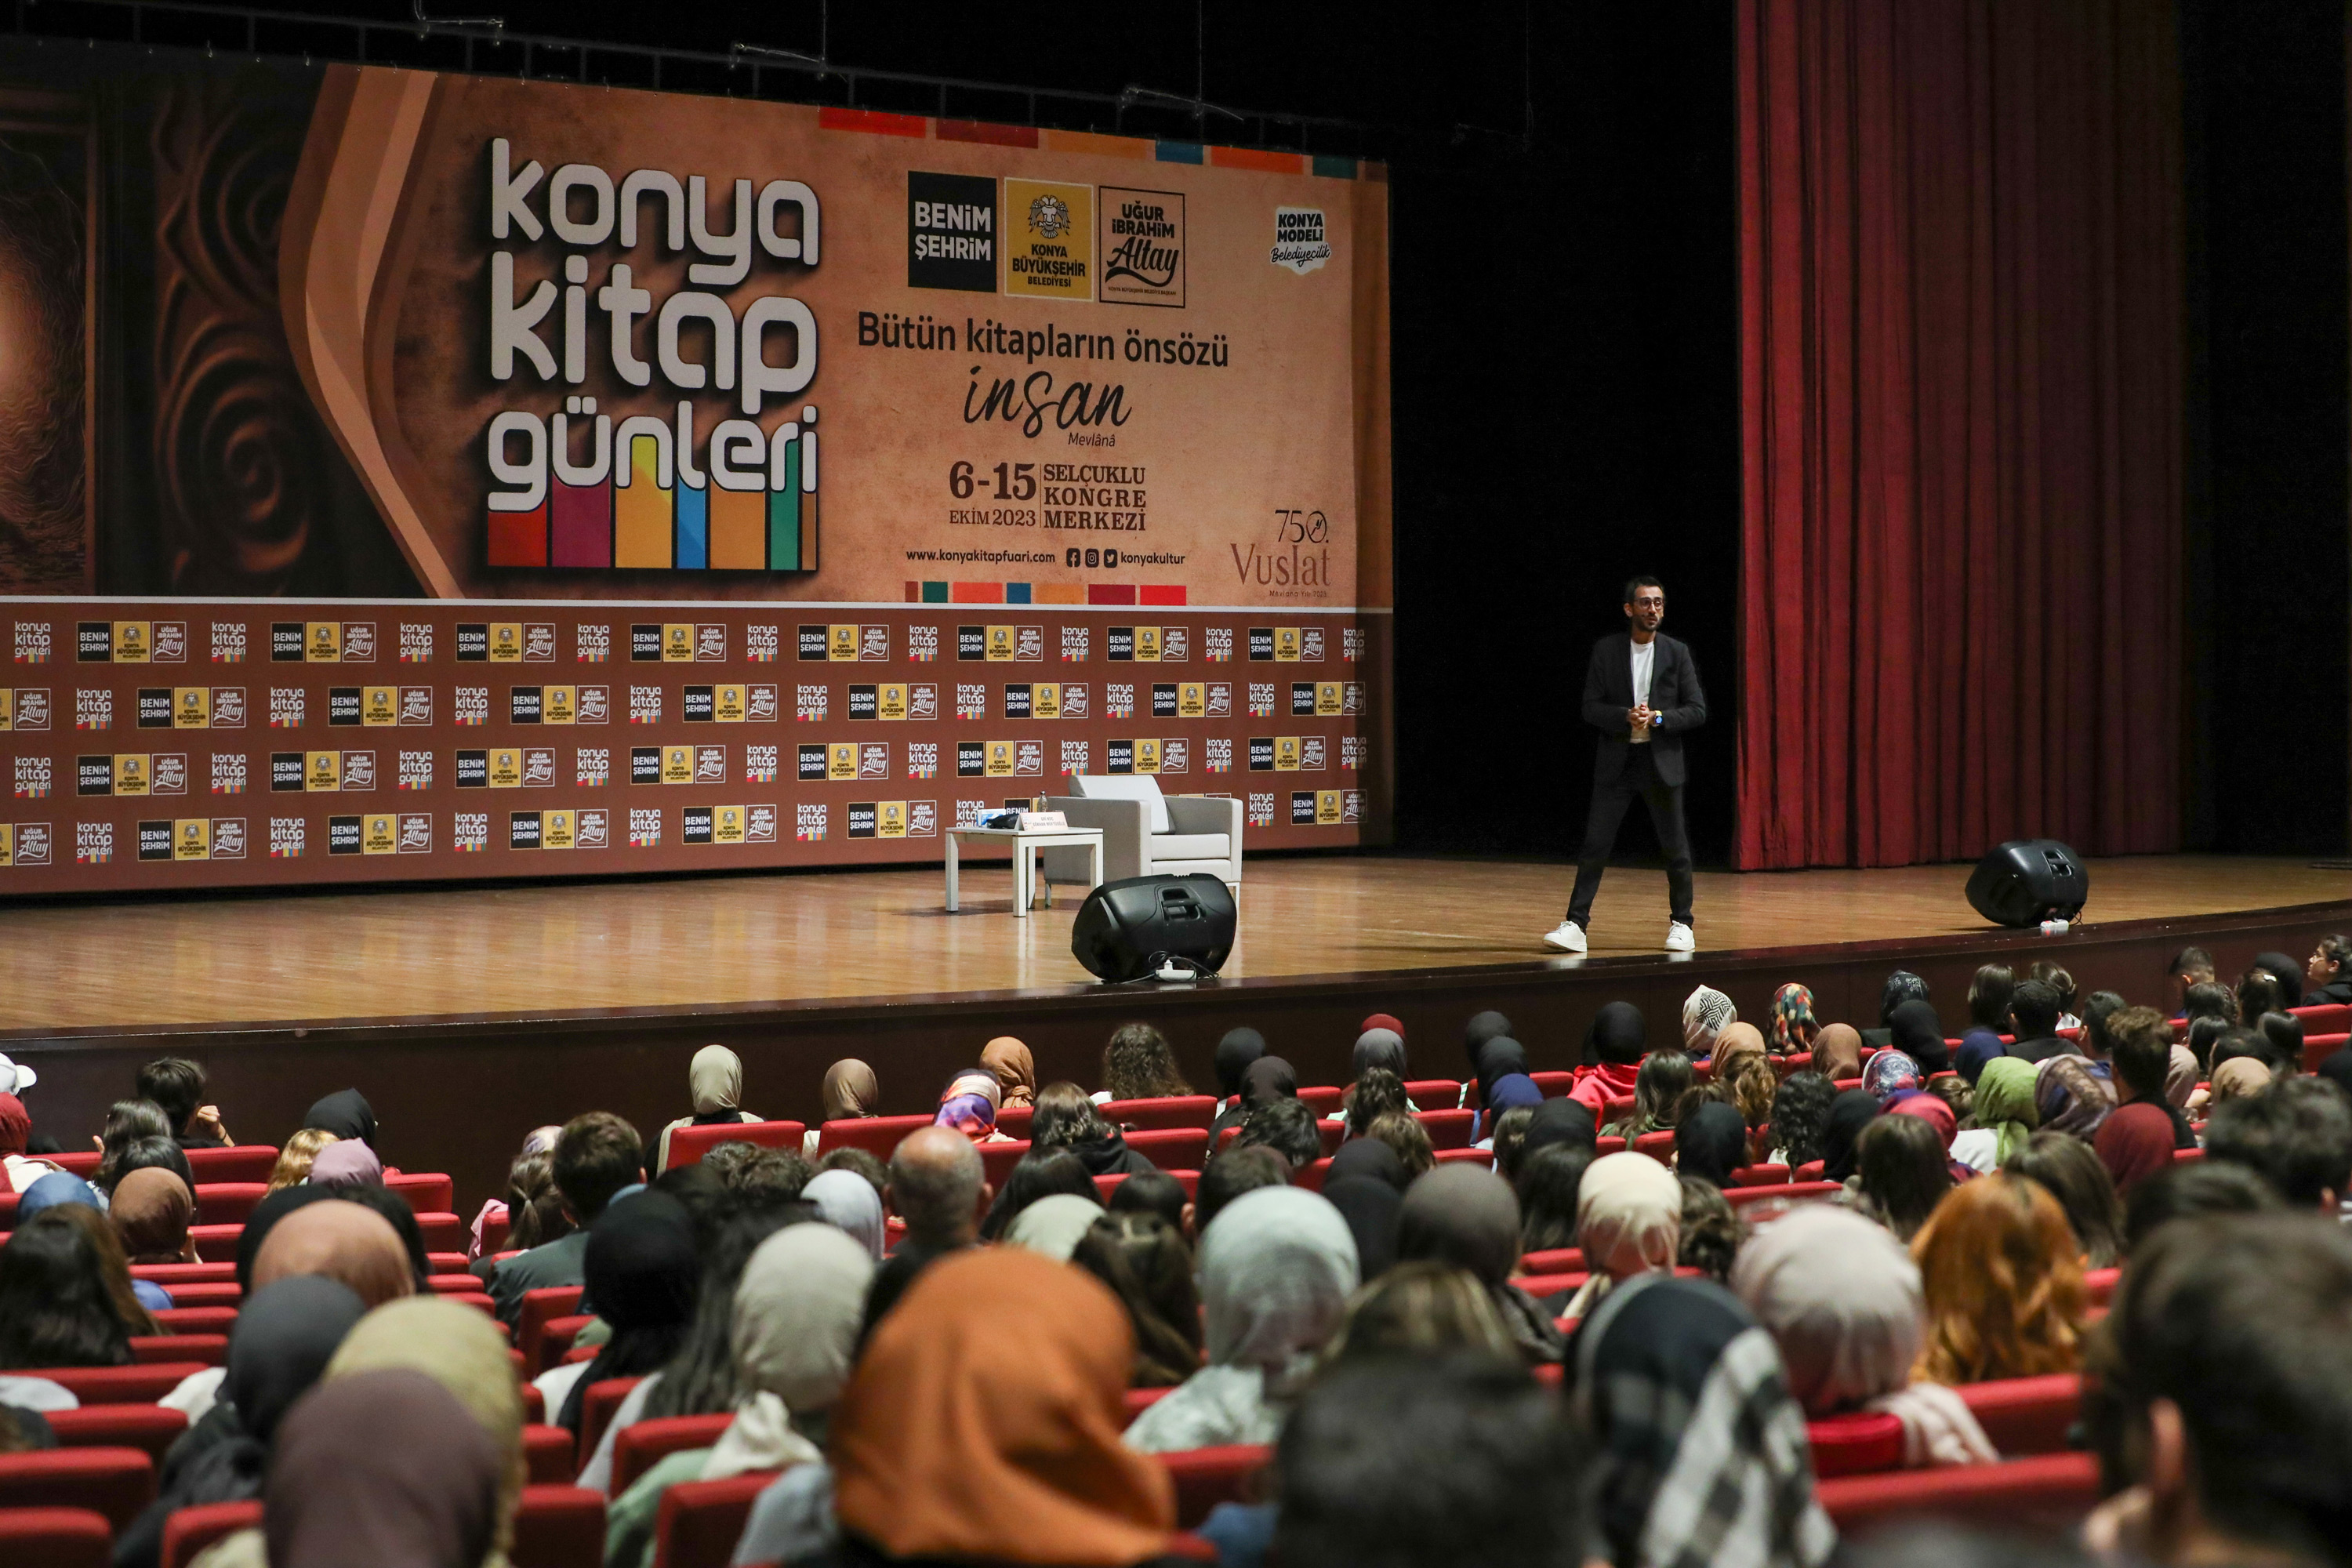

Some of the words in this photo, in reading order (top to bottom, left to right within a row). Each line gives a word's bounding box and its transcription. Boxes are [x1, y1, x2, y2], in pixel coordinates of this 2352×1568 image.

[492, 138, 818, 285] konya
[1122, 201, 1164, 221] UĞUR
[1278, 213, 1323, 227] KONYA
[1031, 244, 1067, 258] KONYA
[1270, 244, 1330, 267] Belediyecilik
[1012, 256, 1085, 277] BÜYÜKŞEHİR
[1105, 237, 1179, 287] Altay
[1028, 276, 1071, 288] BELEDİYESİ
[491, 251, 817, 415] kitap
[858, 311, 956, 350] Bütün
[966, 318, 1114, 364] kitapların
[1124, 328, 1229, 367] önsözü
[964, 365, 1132, 438] insan
[1068, 431, 1116, 448] Mevlânâ
[488, 396, 817, 511] günleri
[949, 461, 1036, 500] 6-15
[1044, 464, 1146, 486] SELÇUKLU
[1044, 487, 1146, 508] KONGRE
[949, 507, 989, 524] EKİM
[993, 510, 1036, 526] 2023
[1044, 508, 1146, 531] MERKEZİ
[906, 549, 1055, 564] www.konyakitapfuari.com
[1120, 551, 1185, 567] konyakultur
[1230, 543, 1331, 586] Vuslat
[15, 622, 50, 635] konya
[401, 622, 433, 635] konya
[578, 624, 609, 636] konya
[909, 625, 938, 636] konya
[1062, 626, 1089, 637] konya
[1207, 627, 1232, 638] konya
[15, 633, 50, 648] kitap
[401, 633, 433, 647] kitap
[578, 634, 609, 648] kitap
[909, 634, 938, 647] kitap
[1062, 636, 1089, 648] kitap
[1207, 636, 1232, 648] kitap
[77, 688, 112, 701] konya
[270, 688, 305, 700] konya
[456, 686, 488, 698] konya
[797, 684, 828, 696] konya
[957, 684, 985, 695] konya
[1107, 683, 1134, 694] konya
[270, 698, 305, 712] kitap
[456, 696, 488, 710] kitap
[797, 694, 828, 707] kitap
[957, 693, 985, 706] kitap
[1107, 692, 1134, 704] kitap
[77, 699, 112, 713] kitap
[577, 748, 609, 760] konya
[747, 745, 778, 757] konya
[15, 757, 51, 770] konya
[212, 753, 246, 766] konya
[577, 758, 609, 771] kitap
[747, 754, 778, 768] kitap
[15, 768, 51, 782] kitap
[212, 764, 246, 779] kitap
[1249, 793, 1274, 804] konya
[630, 808, 661, 820] konya
[1249, 801, 1274, 814] kitap
[455, 812, 488, 824] konya
[630, 818, 661, 832] kitap
[77, 822, 112, 835] konya
[455, 822, 488, 837] kitap
[77, 833, 112, 848] kitap
